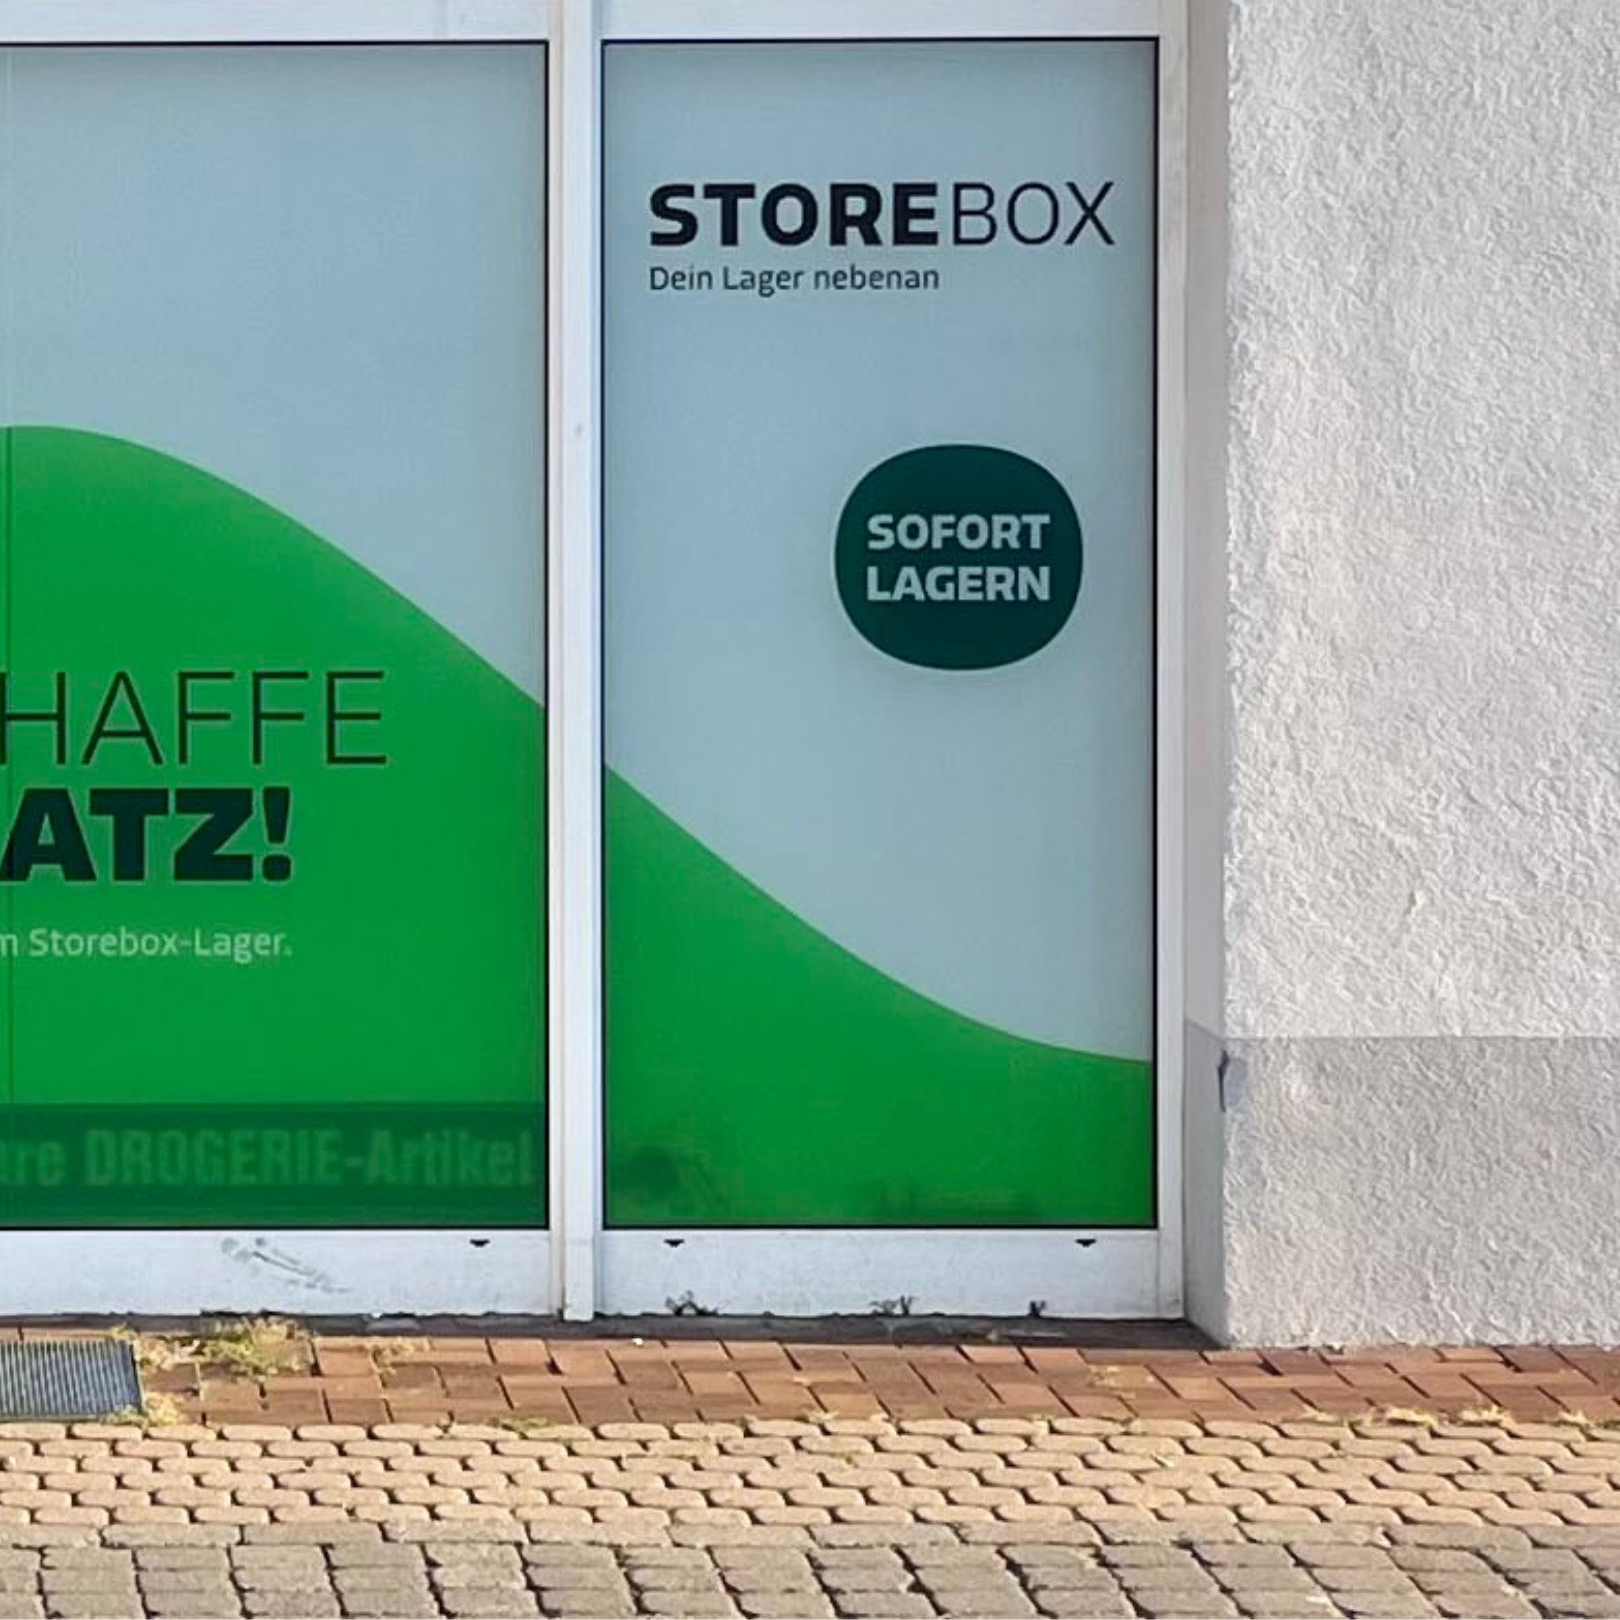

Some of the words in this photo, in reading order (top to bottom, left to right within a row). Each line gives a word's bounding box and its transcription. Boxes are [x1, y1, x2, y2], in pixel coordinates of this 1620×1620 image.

[650, 182, 1114, 246] STOREBOX
[650, 265, 713, 290] Dein
[723, 266, 802, 297] Lager
[814, 264, 938, 290] nebenan
[867, 514, 1050, 550] SOFORT
[867, 566, 1050, 601] LAGERN
[29, 926, 292, 963] Storebox-Lager.
[85, 1128, 536, 1188] DROGERIE-Artikel
